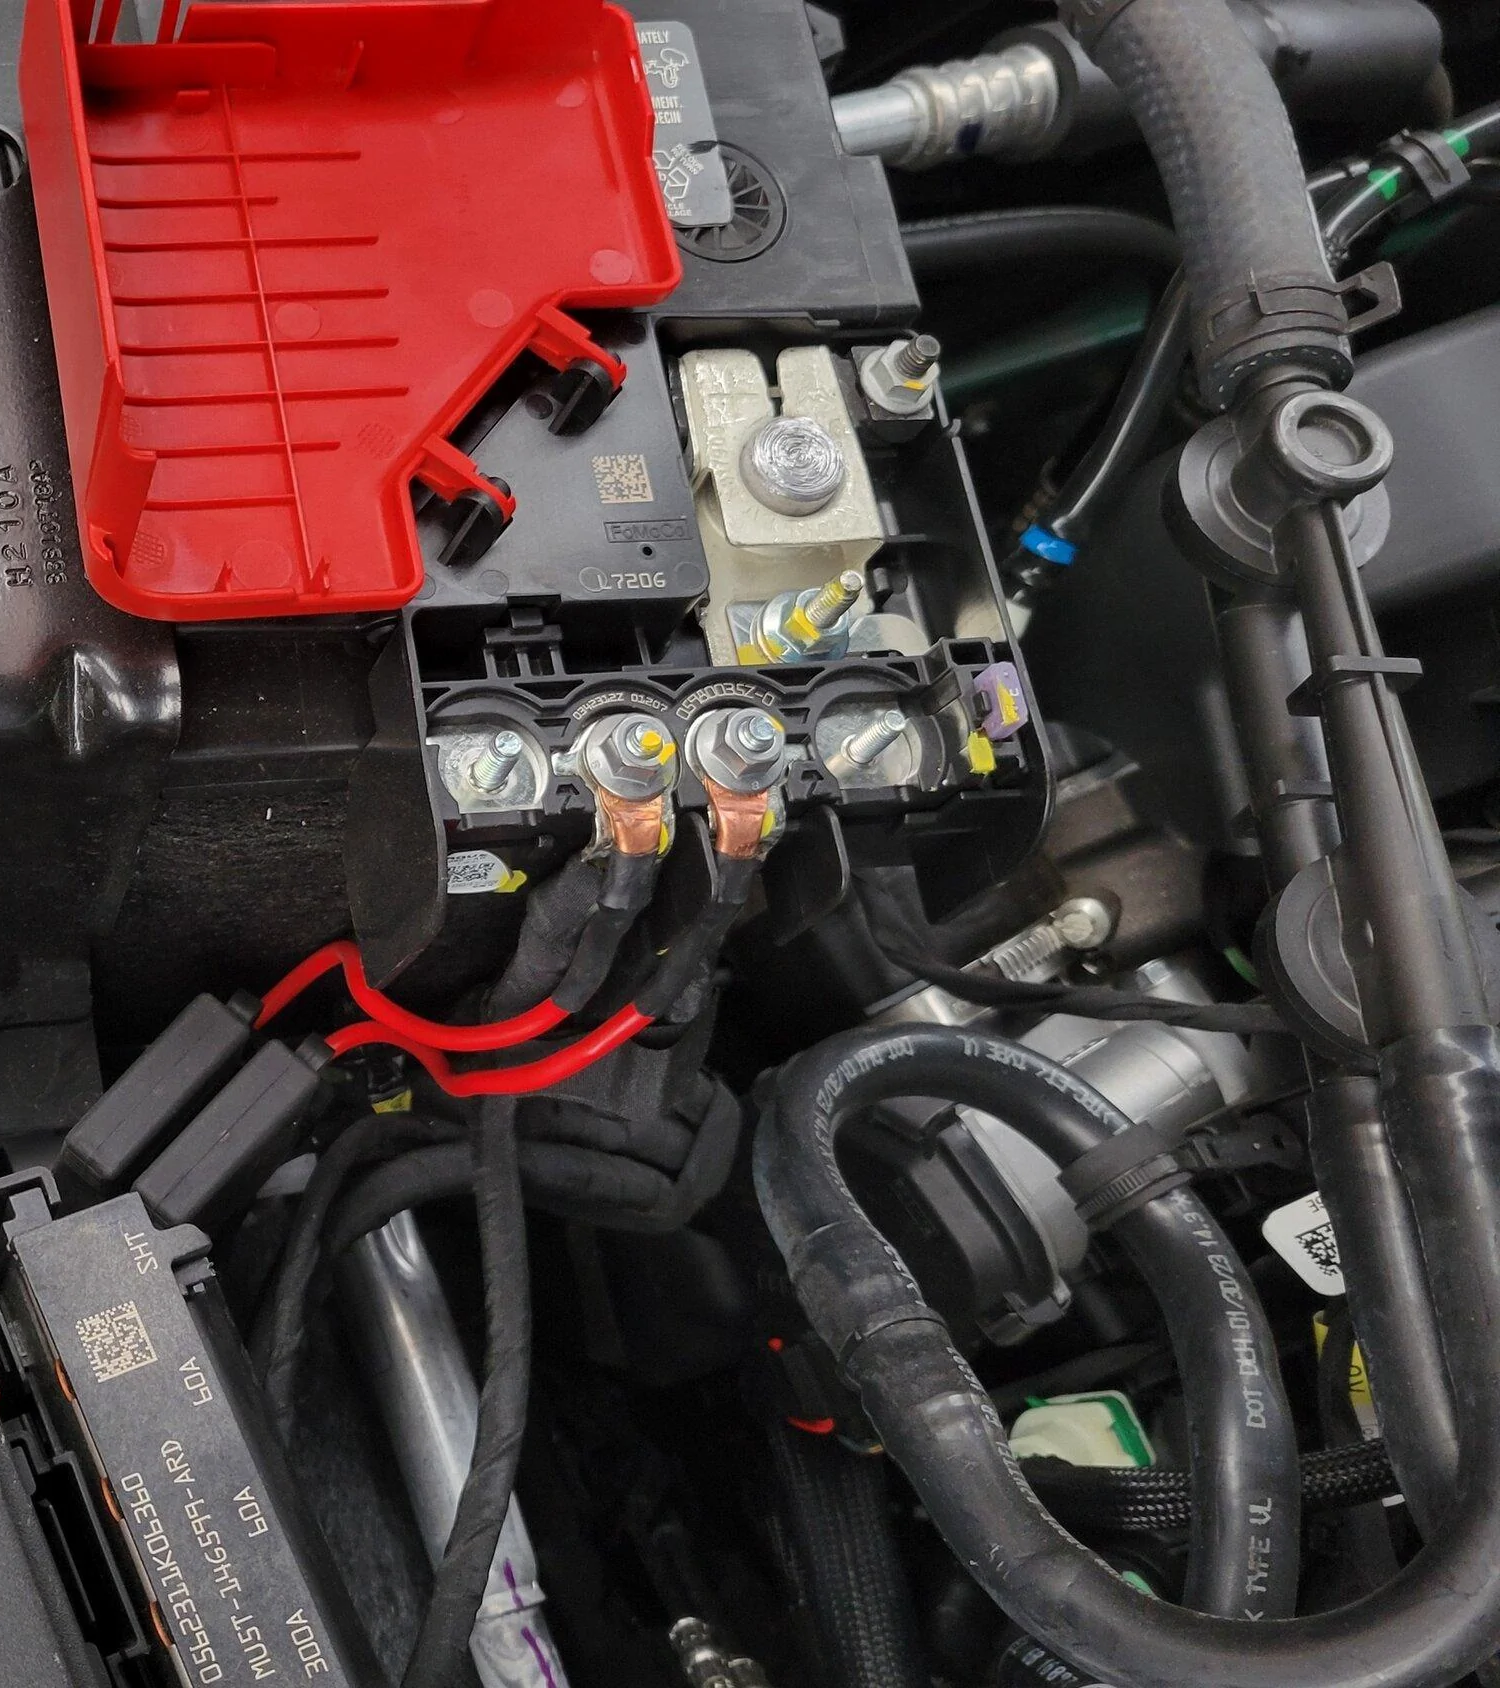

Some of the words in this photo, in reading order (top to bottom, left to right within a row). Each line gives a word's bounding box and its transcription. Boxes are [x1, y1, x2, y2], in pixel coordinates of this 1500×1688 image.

[610, 523, 685, 539] FoMoCo
[123, 1231, 159, 1276] SHT
[178, 1355, 214, 1407] 60A
[1242, 1385, 1267, 1430] DOT
[232, 1485, 269, 1538] 60A
[285, 1608, 329, 1680] 300A
